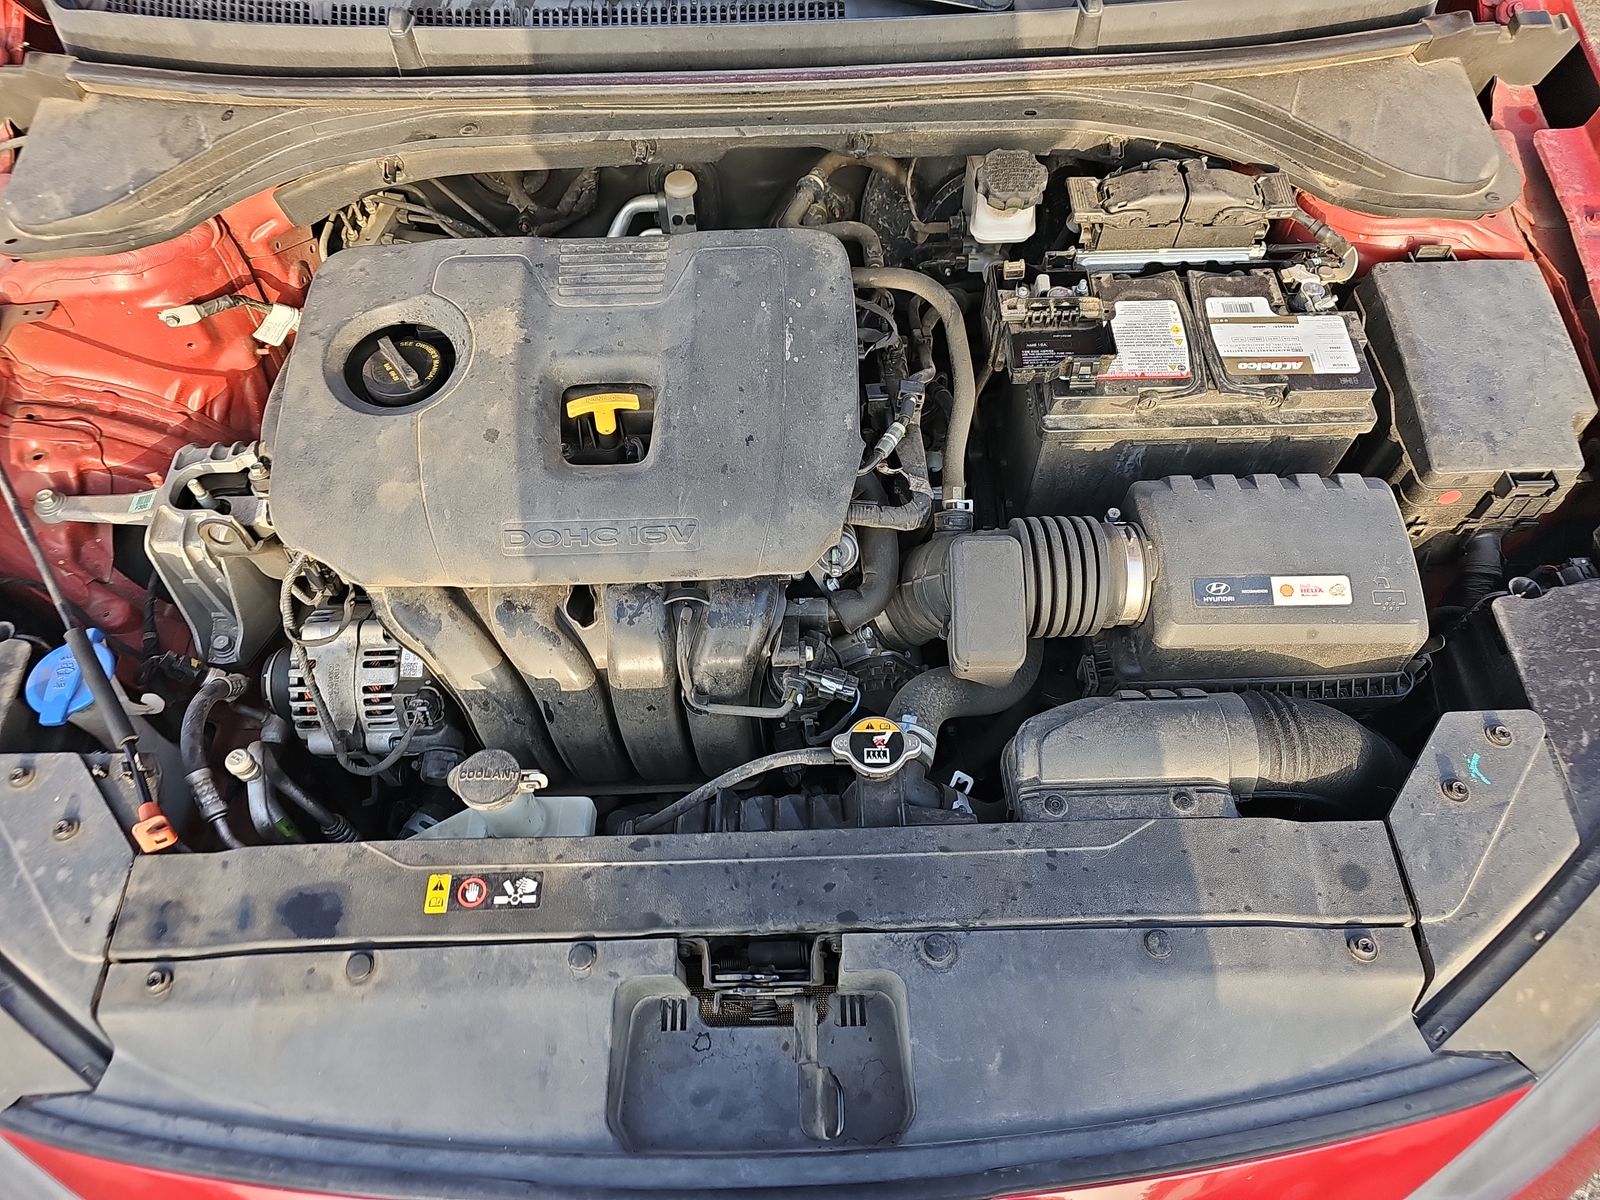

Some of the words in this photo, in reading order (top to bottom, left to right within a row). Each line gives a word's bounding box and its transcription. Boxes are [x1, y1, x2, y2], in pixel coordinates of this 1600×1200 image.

[424, 359, 440, 381] MANUAL
[1237, 361, 1304, 371] ACDelco
[503, 526, 619, 548] DOHC
[629, 524, 697, 545] 16V
[460, 767, 519, 780] COOLANT
